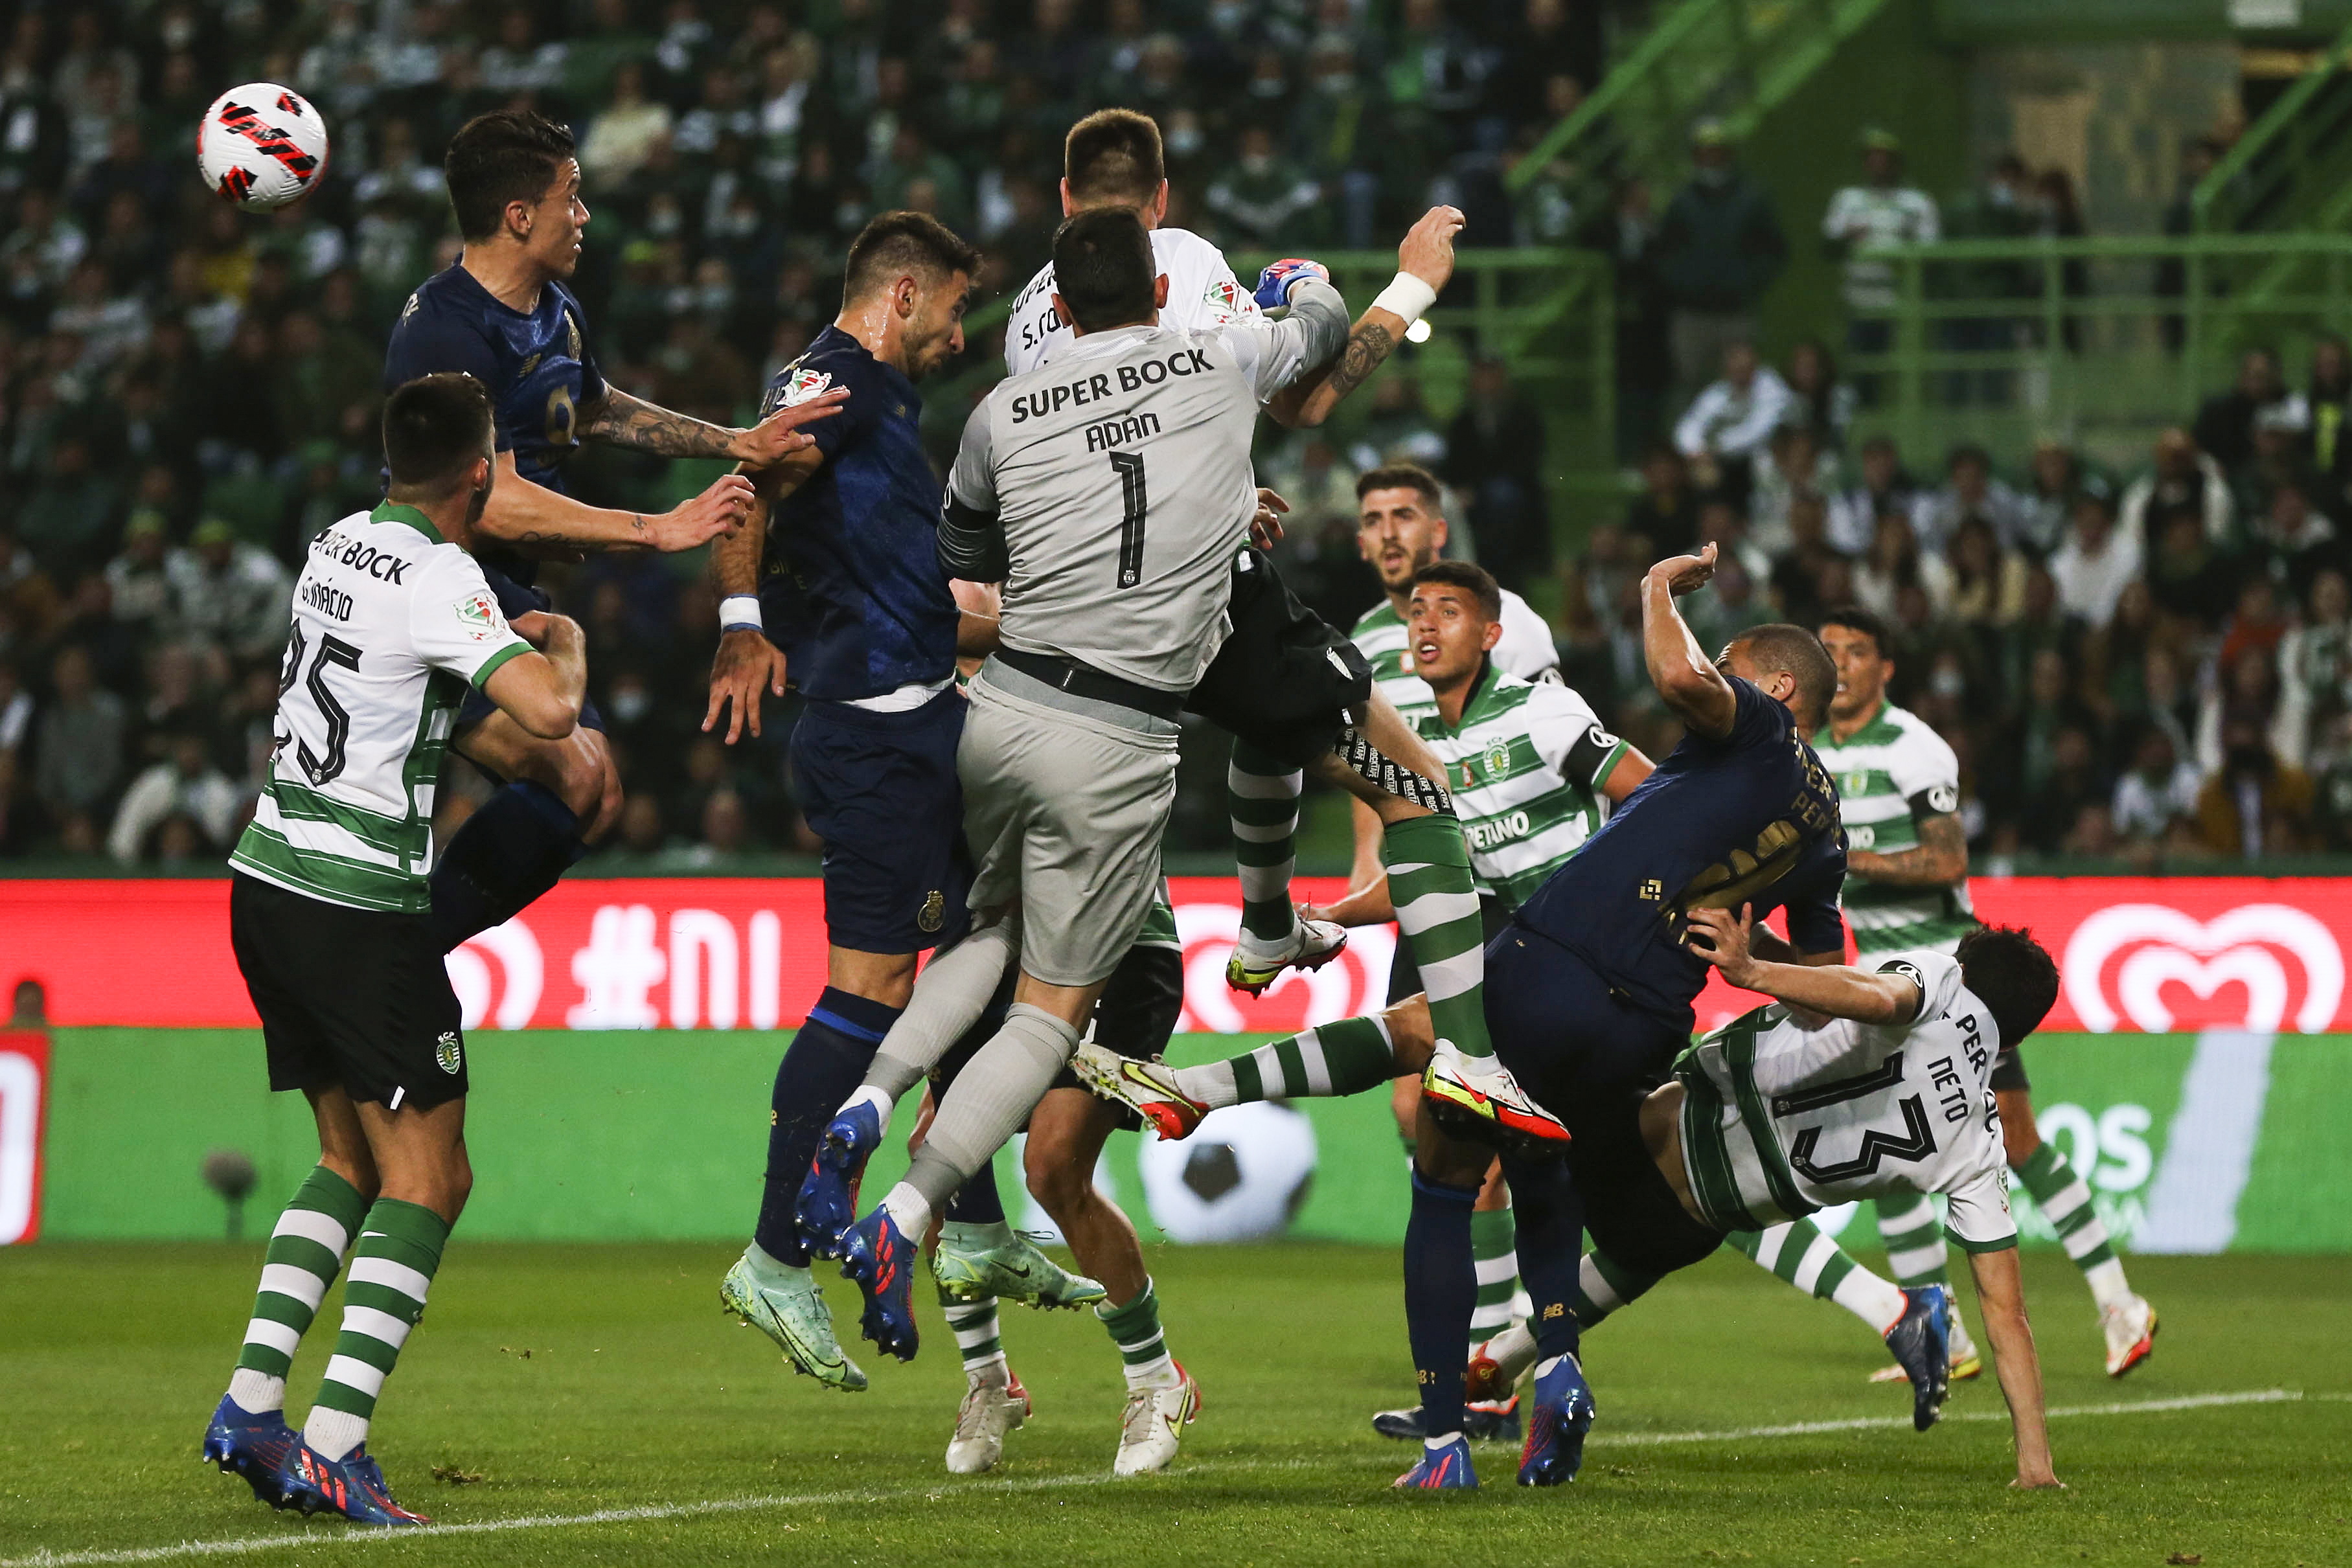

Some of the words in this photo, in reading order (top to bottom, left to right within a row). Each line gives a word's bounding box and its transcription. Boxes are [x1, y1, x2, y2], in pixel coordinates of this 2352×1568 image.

[1012, 373, 1113, 424] SUPER
[1116, 348, 1215, 393] BOCK
[1108, 451, 1147, 589] 1
[341, 541, 413, 586] BOCK
[437, 1031, 455, 1043] SCP
[1772, 1051, 1938, 1185] 13
[1926, 1056, 1969, 1123] NETO
